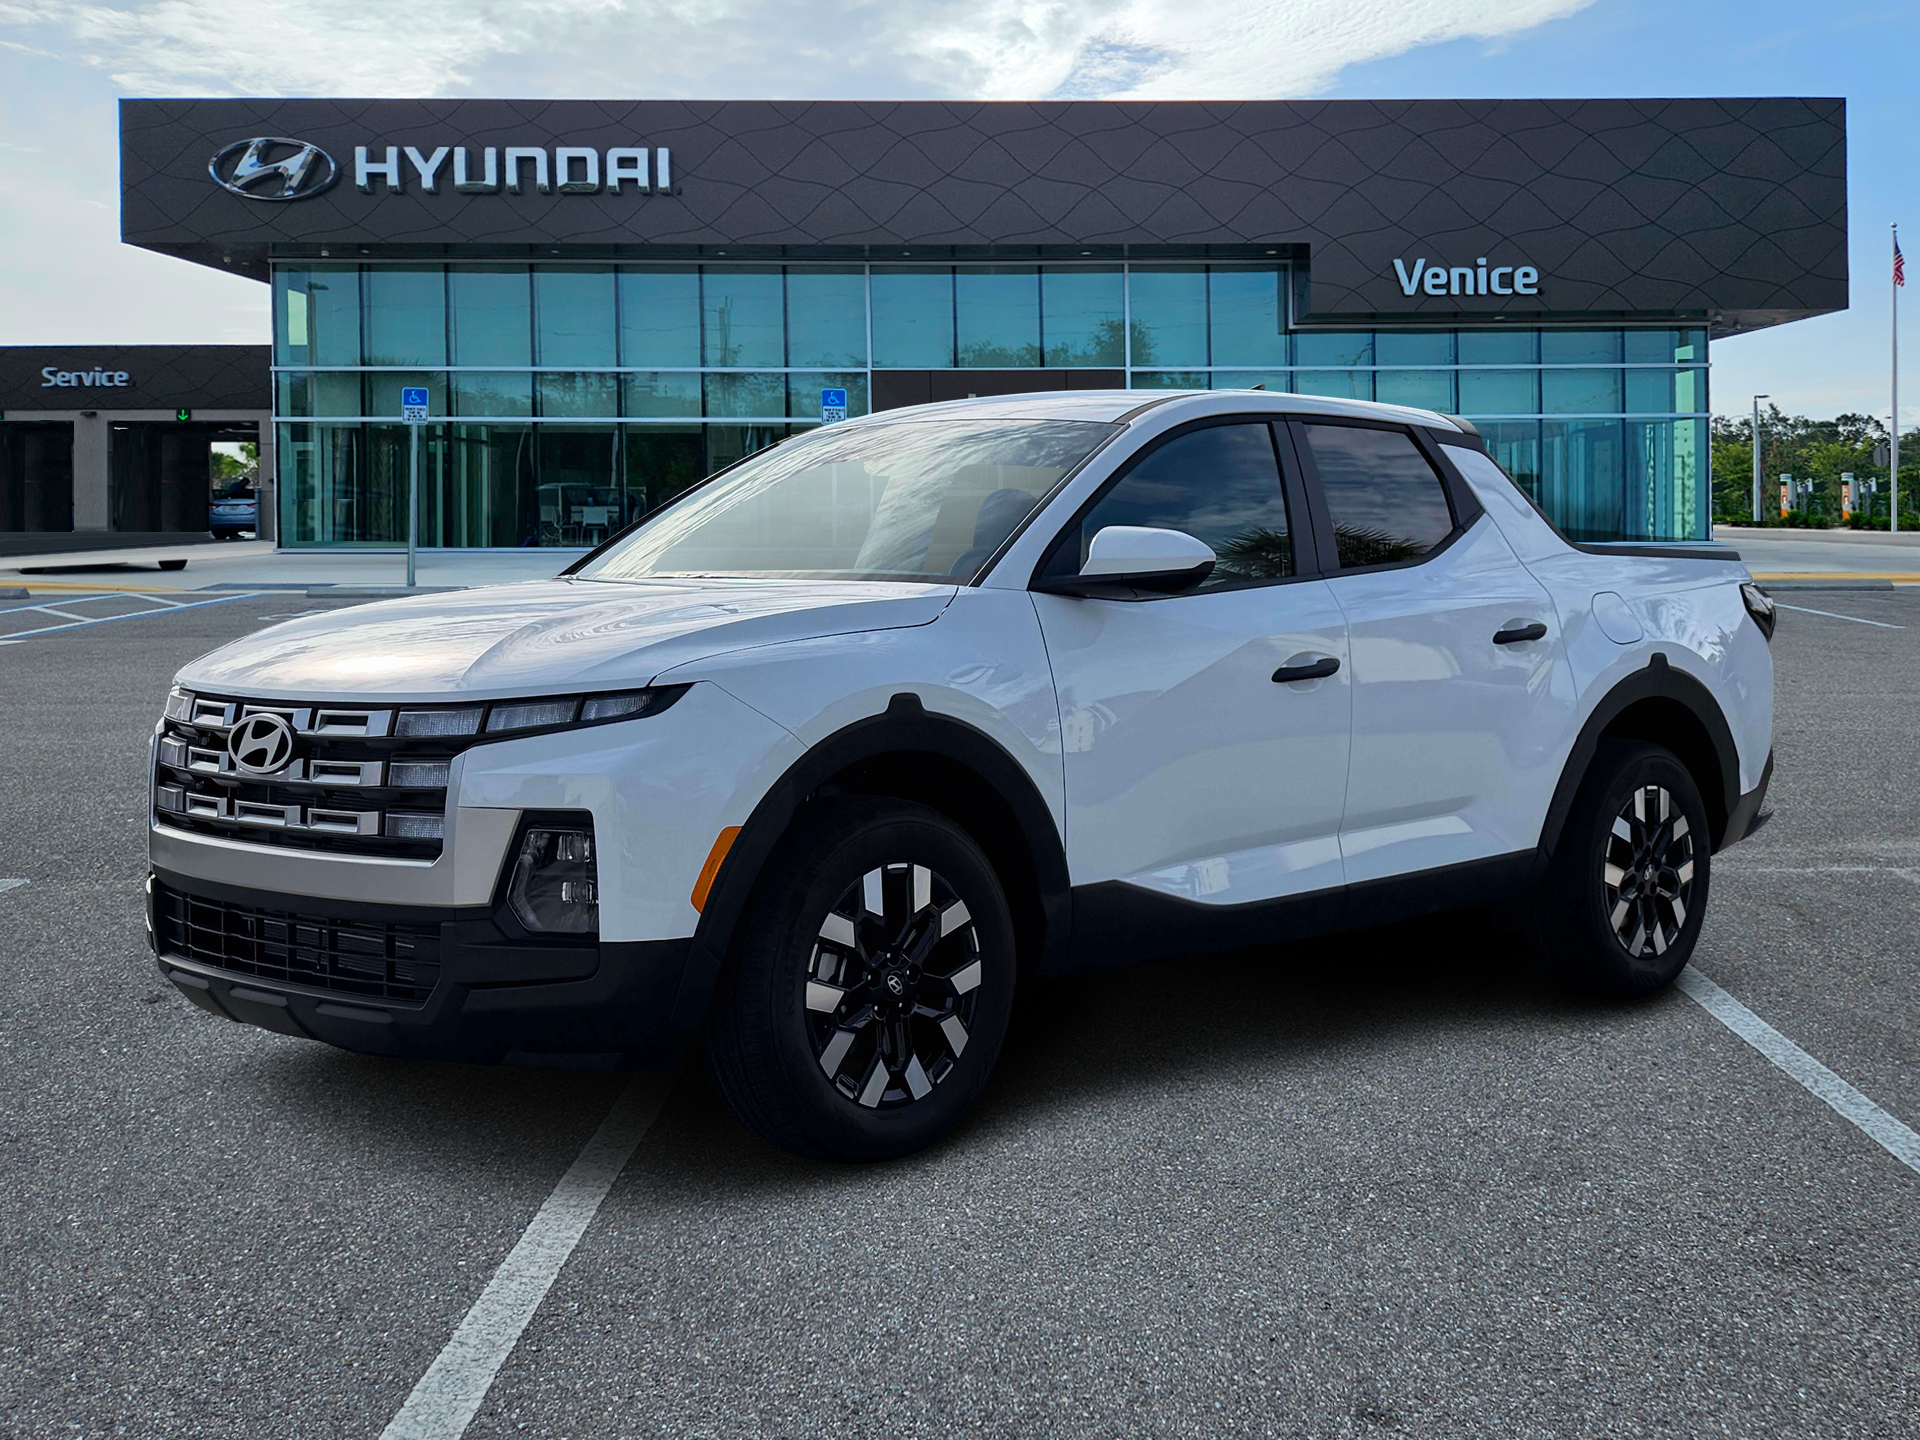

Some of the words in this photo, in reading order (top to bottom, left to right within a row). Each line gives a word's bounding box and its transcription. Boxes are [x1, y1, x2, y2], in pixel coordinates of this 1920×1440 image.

[354, 146, 672, 194] HYUNDAI
[1392, 257, 1539, 296] Venice
[41, 366, 130, 388] Service
